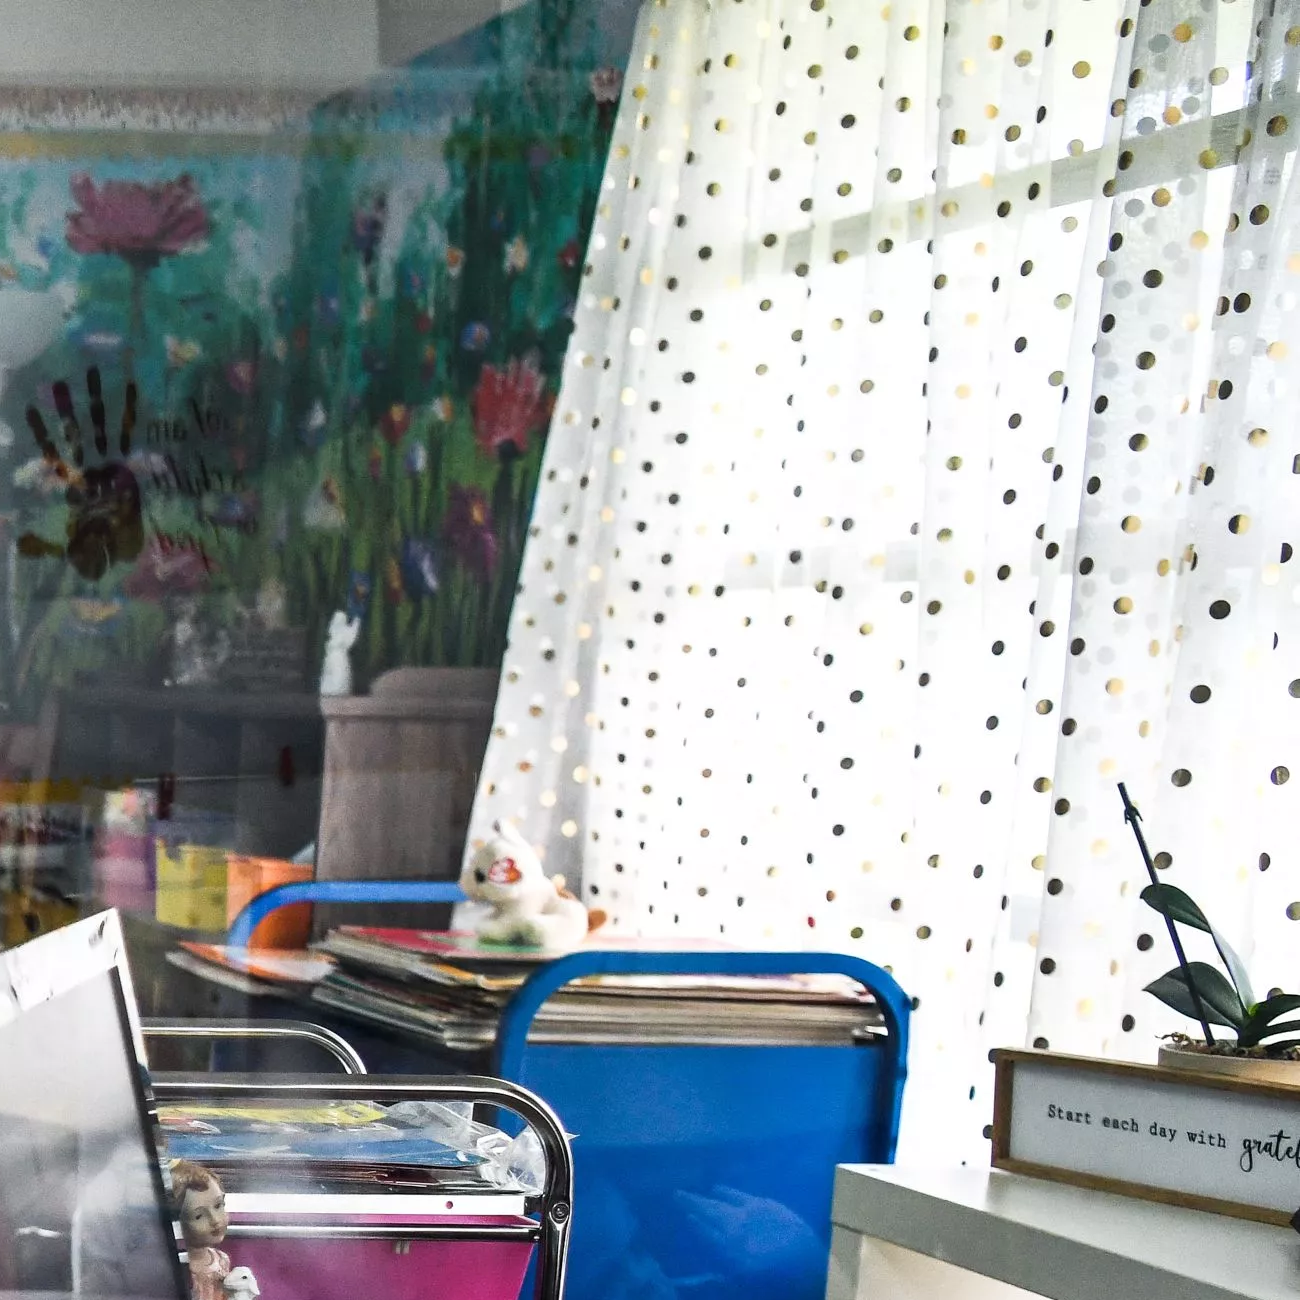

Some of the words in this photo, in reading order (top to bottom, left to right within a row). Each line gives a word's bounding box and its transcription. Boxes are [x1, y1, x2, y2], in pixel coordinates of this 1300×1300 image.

[1047, 1103, 1092, 1125] Start
[1102, 1115, 1139, 1133] each
[1149, 1122, 1177, 1143] day
[1187, 1130, 1227, 1149] with
